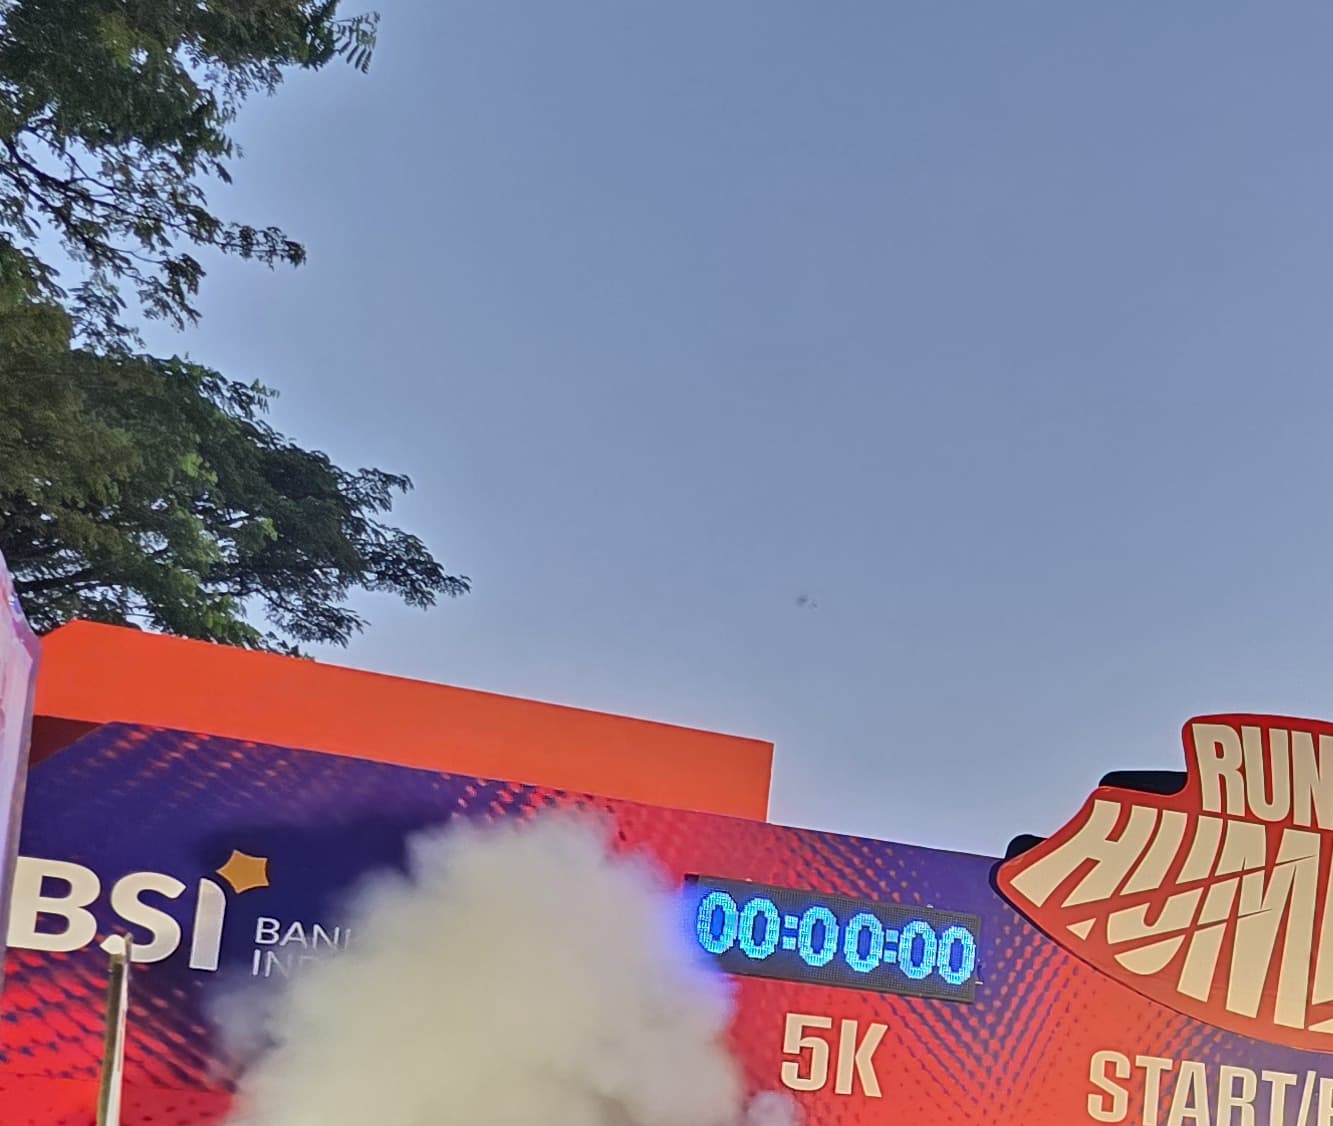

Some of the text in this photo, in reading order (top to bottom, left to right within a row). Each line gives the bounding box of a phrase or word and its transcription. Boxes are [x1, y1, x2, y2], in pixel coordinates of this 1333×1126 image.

[6, 856, 226, 971] BSI
[255, 917, 352, 950] BAN
[697, 891, 976, 985] 00:00:00
[781, 1013, 888, 1097] 5K
